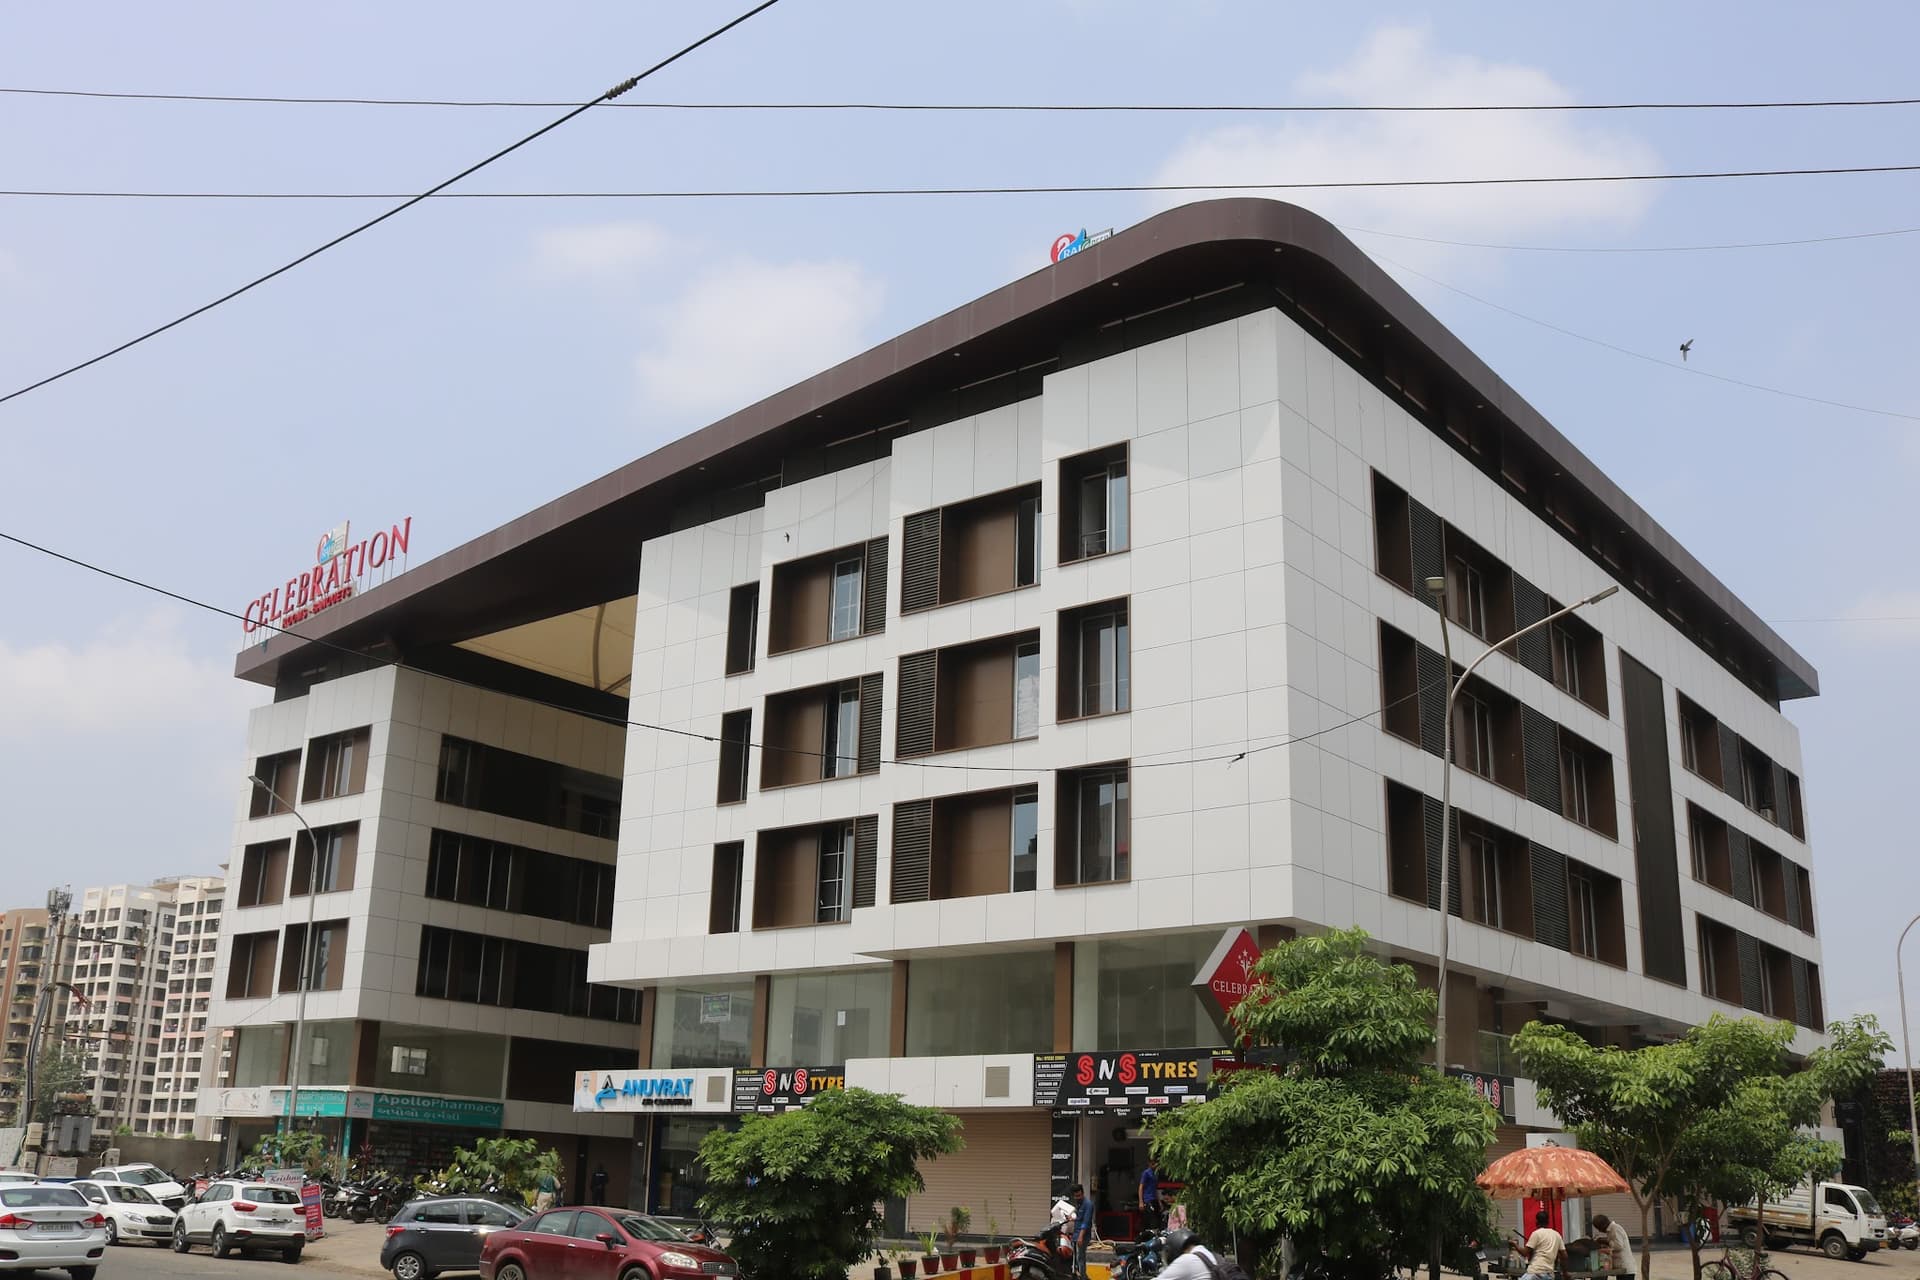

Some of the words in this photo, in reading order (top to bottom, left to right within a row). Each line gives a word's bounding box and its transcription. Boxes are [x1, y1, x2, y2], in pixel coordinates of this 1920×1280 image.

[242, 516, 412, 633] CELEBRATION
[1212, 979, 1259, 997] CELEBRA
[1140, 1061, 1198, 1079] TYRES
[621, 1077, 694, 1097] ANUVRAT
[810, 1076, 844, 1091] TYRE
